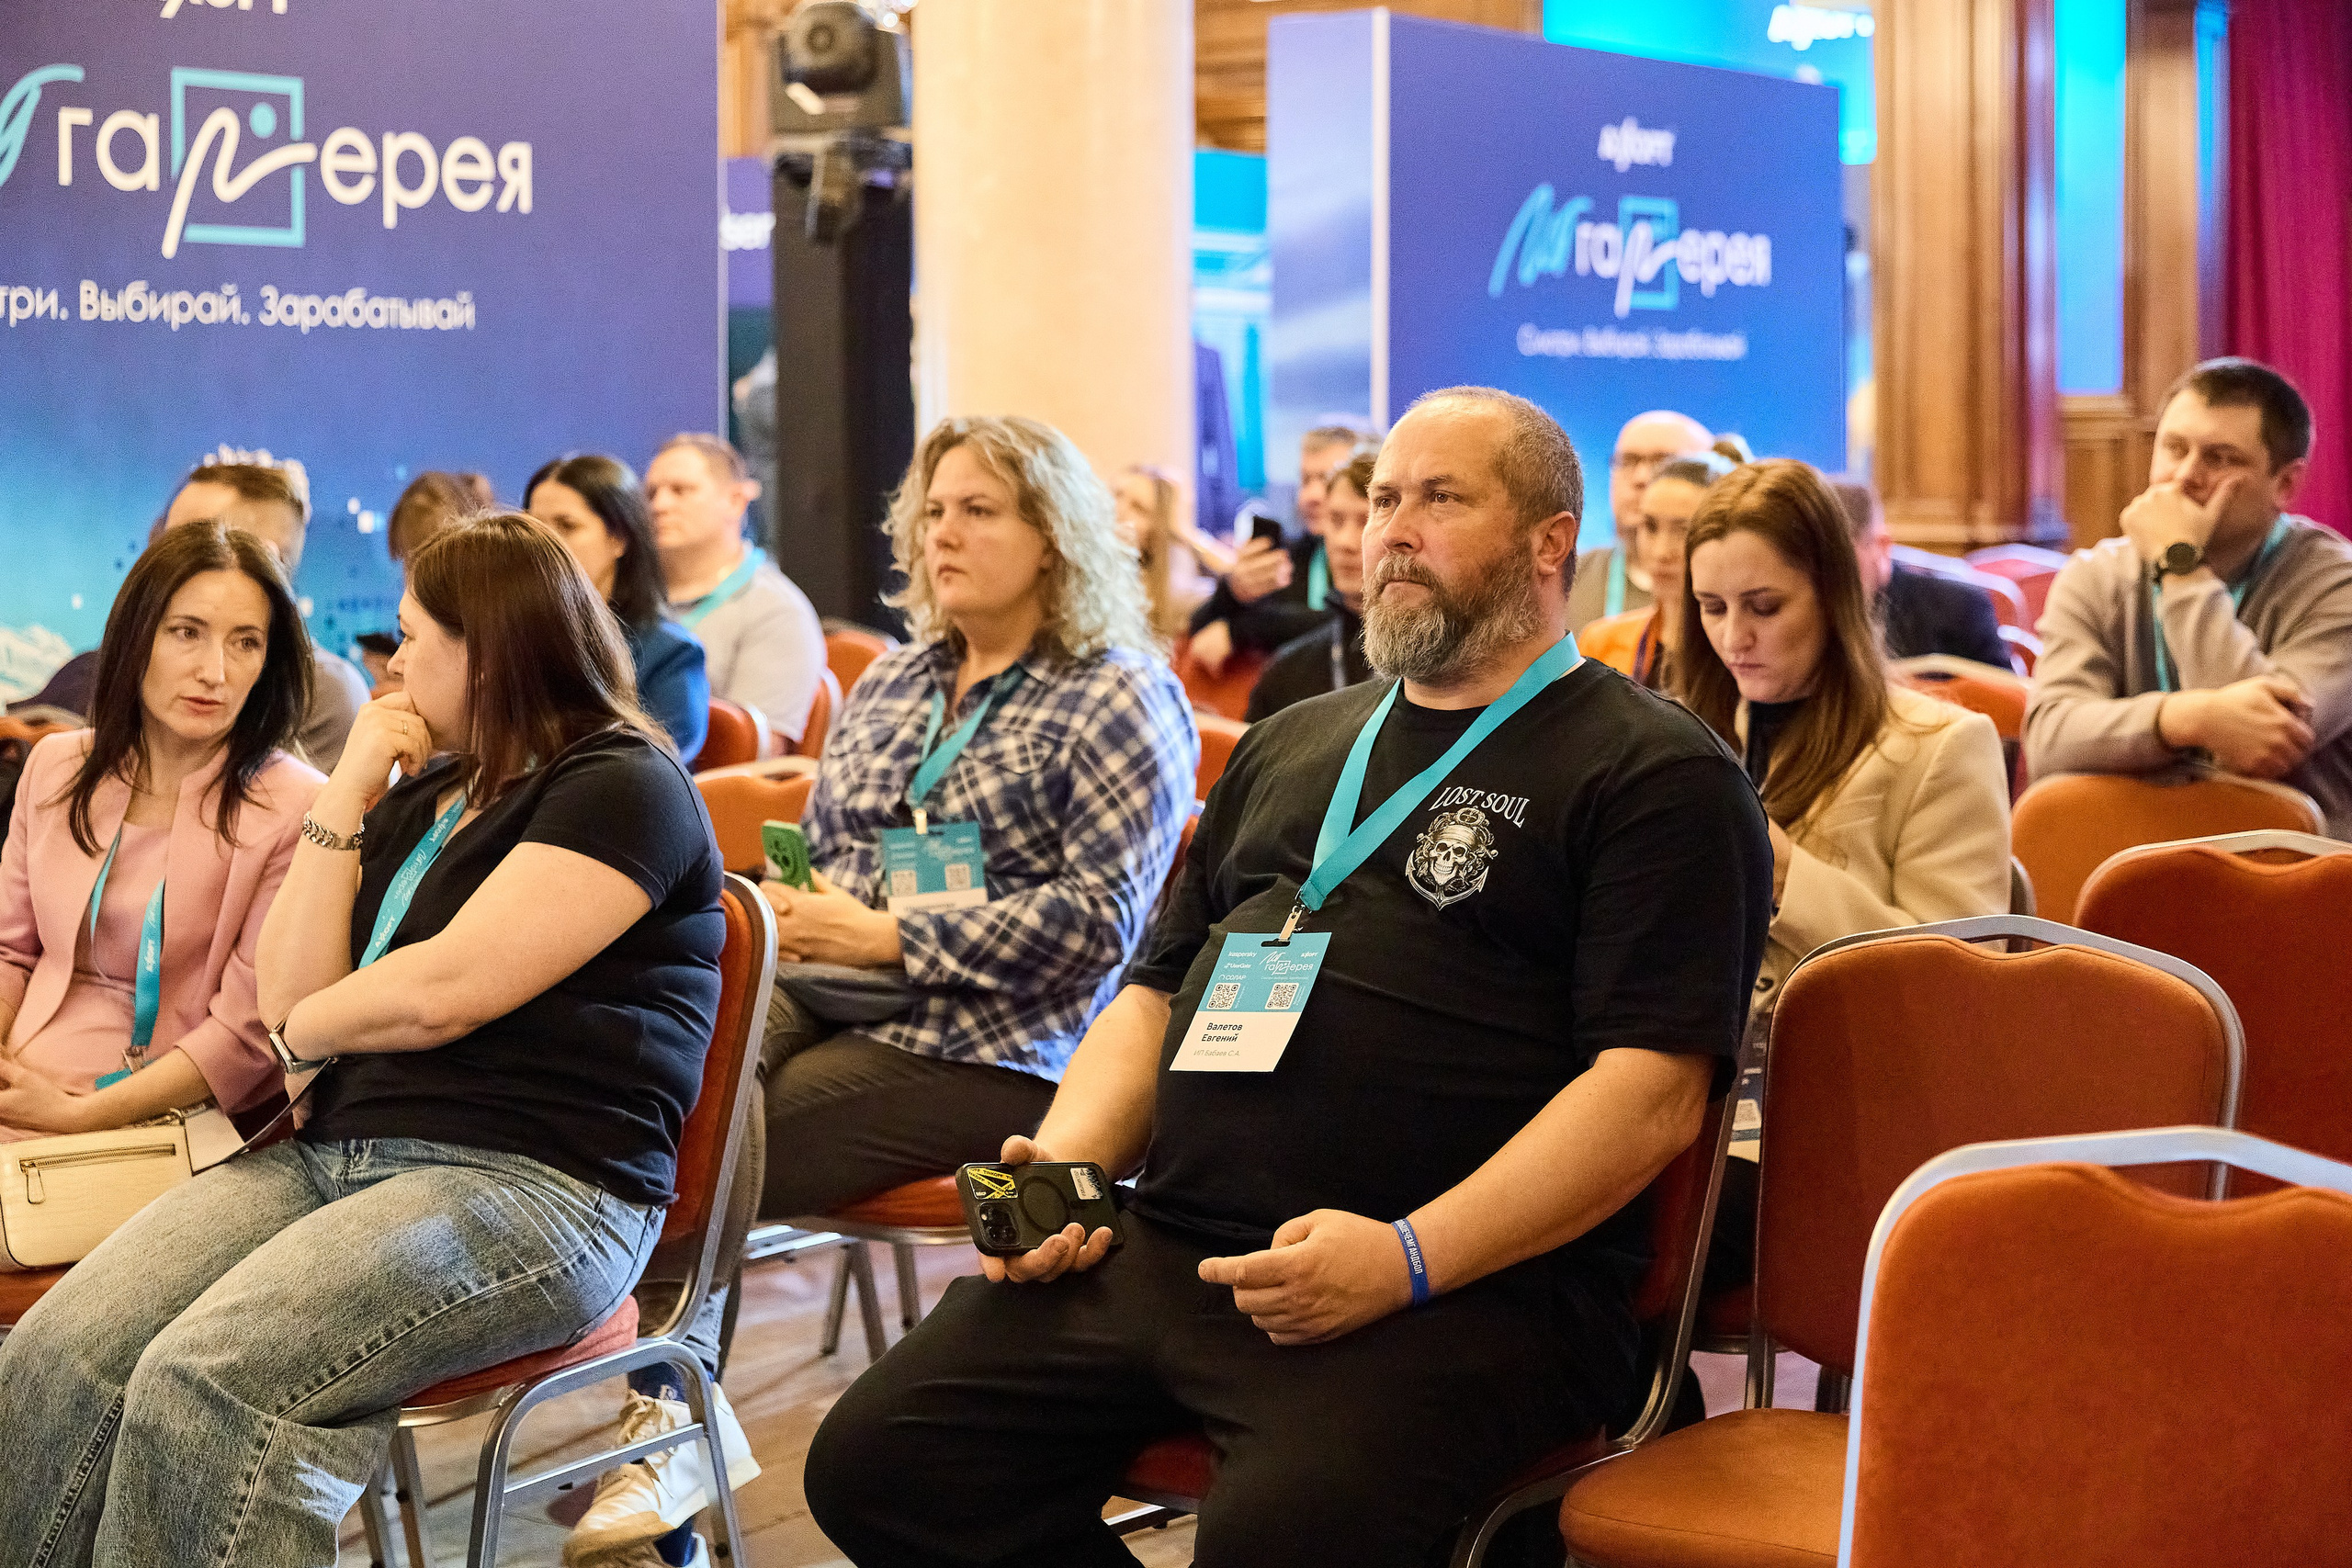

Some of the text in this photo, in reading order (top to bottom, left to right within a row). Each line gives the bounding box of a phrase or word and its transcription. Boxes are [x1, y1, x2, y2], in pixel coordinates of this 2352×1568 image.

[79, 278, 251, 333] Выбирай.
[259, 285, 477, 334] Зарабатывай
[1428, 785, 1531, 829] LOST SOUL
[1201, 1033, 1238, 1043] Евгений
[1206, 1022, 1243, 1031] Валетов
